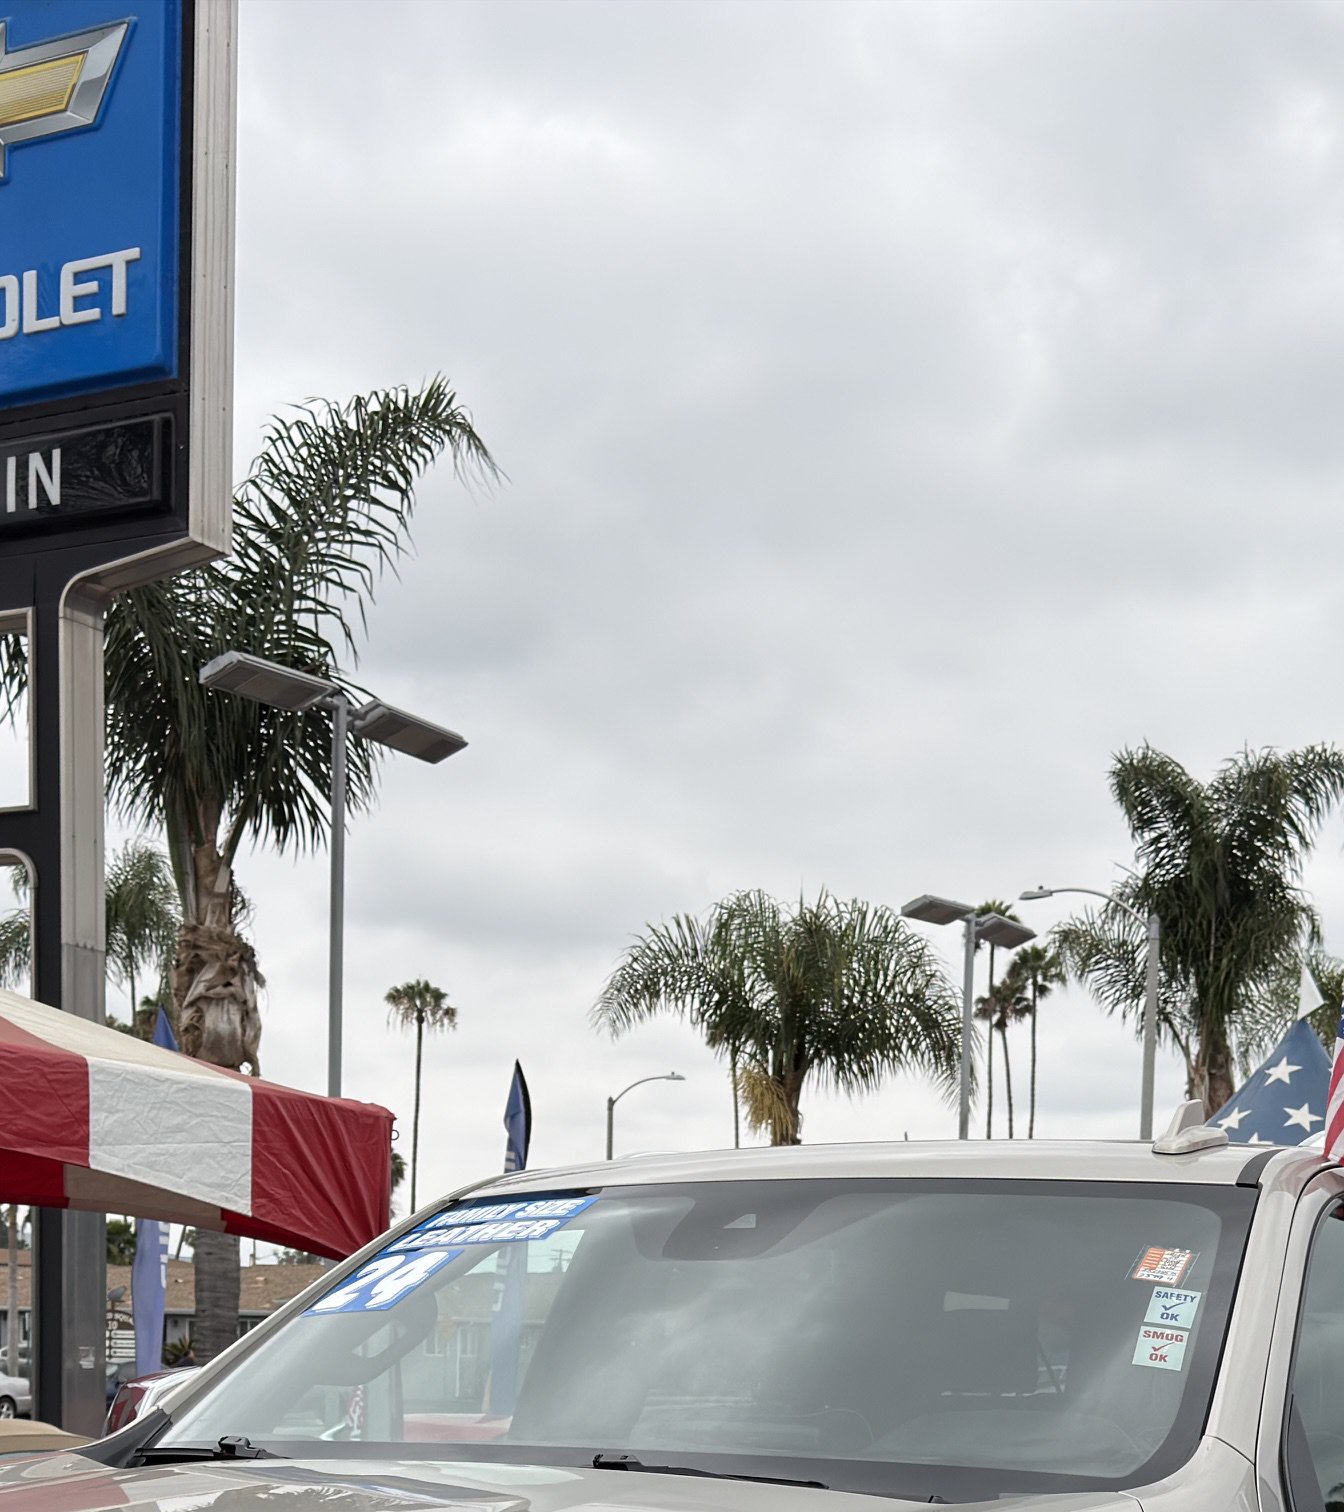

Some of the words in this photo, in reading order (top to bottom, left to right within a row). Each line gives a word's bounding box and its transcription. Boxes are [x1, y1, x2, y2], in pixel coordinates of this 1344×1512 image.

[425, 1202, 527, 1229] FAMILY
[514, 1199, 586, 1219] SIZE
[392, 1219, 560, 1251] LEATHER
[311, 1251, 450, 1312] 24
[1154, 1290, 1197, 1303] SAFETY
[1160, 1312, 1180, 1321] OK
[1143, 1330, 1184, 1343] SMOG
[1149, 1353, 1169, 1363] OK
